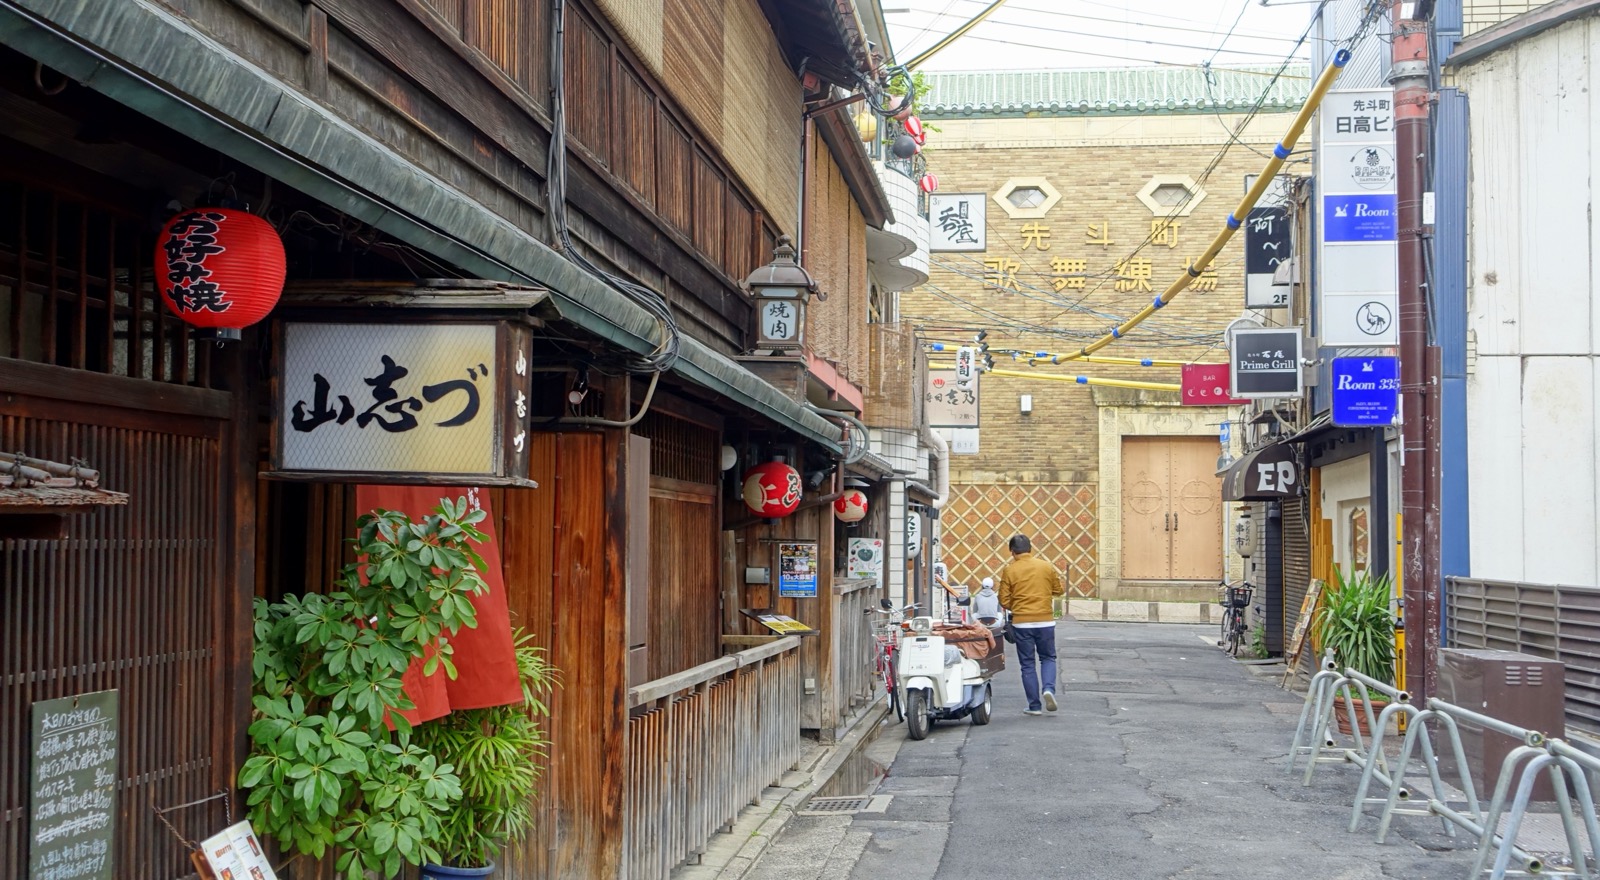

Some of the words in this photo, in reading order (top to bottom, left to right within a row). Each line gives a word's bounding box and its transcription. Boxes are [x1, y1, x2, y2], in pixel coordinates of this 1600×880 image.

[1353, 100, 1390, 111] 先斗町
[1336, 116, 1395, 133] 日高ビ
[1355, 166, 1391, 176] BAMBI
[1354, 203, 1389, 217] Room
[1020, 221, 1181, 250] 先斗町
[164, 212, 232, 314] お好み焼
[983, 255, 1218, 293] 歌舞練場
[1273, 295, 1288, 304] 2F
[770, 302, 790, 338] 焼肉
[960, 351, 970, 377] 寿司
[1240, 360, 1270, 369] Prime
[1271, 359, 1295, 369] Grill
[291, 355, 489, 432] 山志づ
[1337, 374, 1376, 390] Room
[1379, 378, 1400, 390] 335
[514, 350, 527, 453] 山志づ
[1257, 461, 1296, 493] EP
[1235, 523, 1246, 549] 串市
